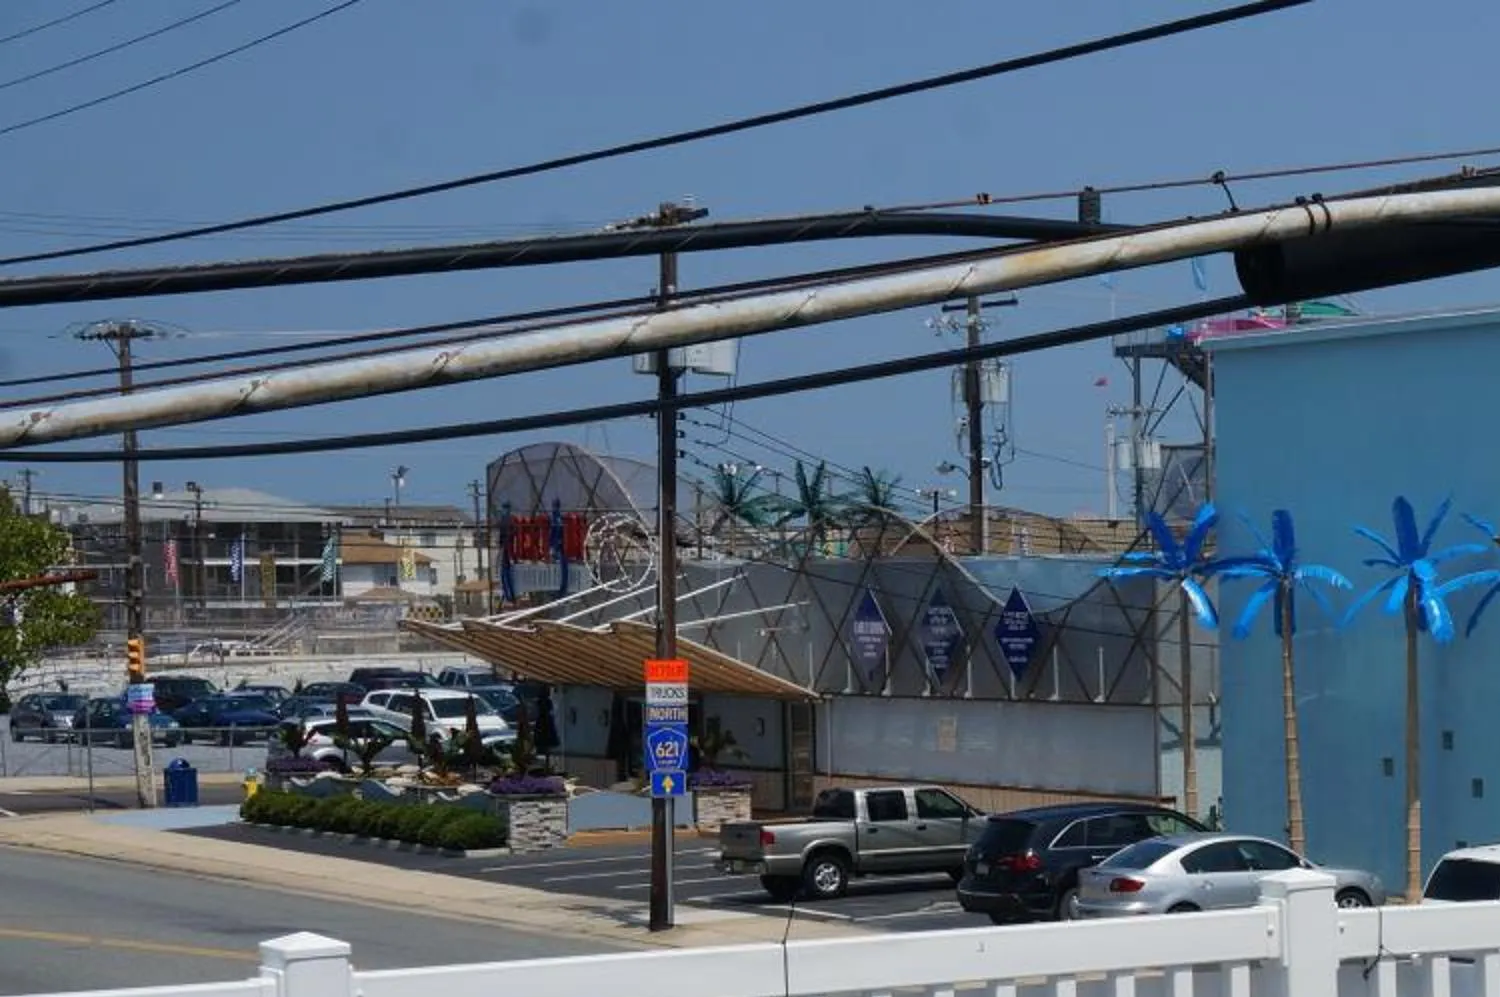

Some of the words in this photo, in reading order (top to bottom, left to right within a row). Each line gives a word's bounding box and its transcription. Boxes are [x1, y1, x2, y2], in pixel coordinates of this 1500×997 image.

[650, 687, 685, 699] TRUCKS
[648, 707, 686, 721] NORTH
[656, 741, 679, 758] 621
